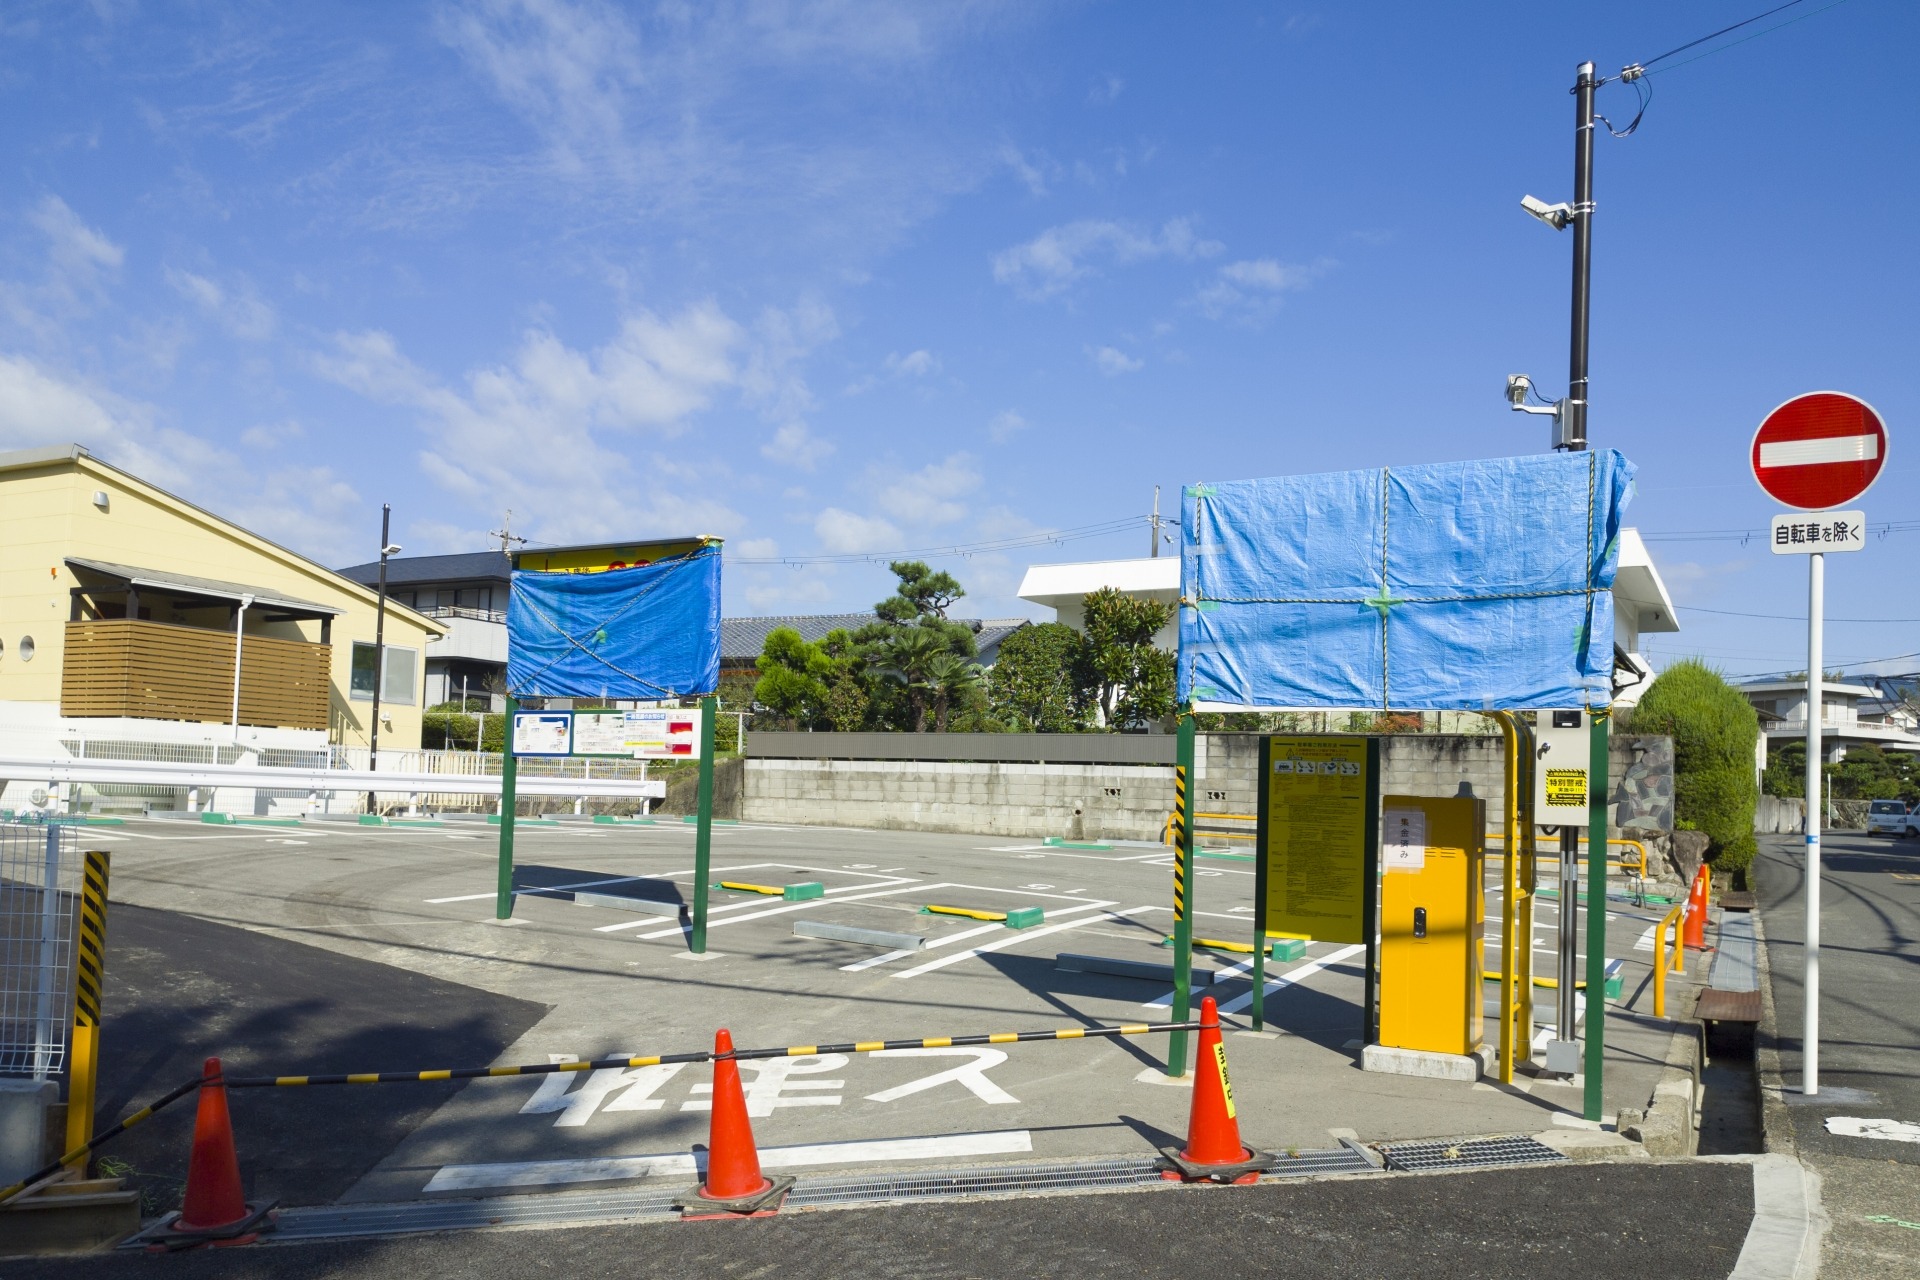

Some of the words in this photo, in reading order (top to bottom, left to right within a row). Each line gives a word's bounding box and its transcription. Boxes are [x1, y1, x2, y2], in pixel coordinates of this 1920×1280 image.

[1776, 521, 1860, 545] 自転車を除く
[1549, 778, 1584, 787] 特別警戒
[1400, 817, 1409, 858] 集金済み
